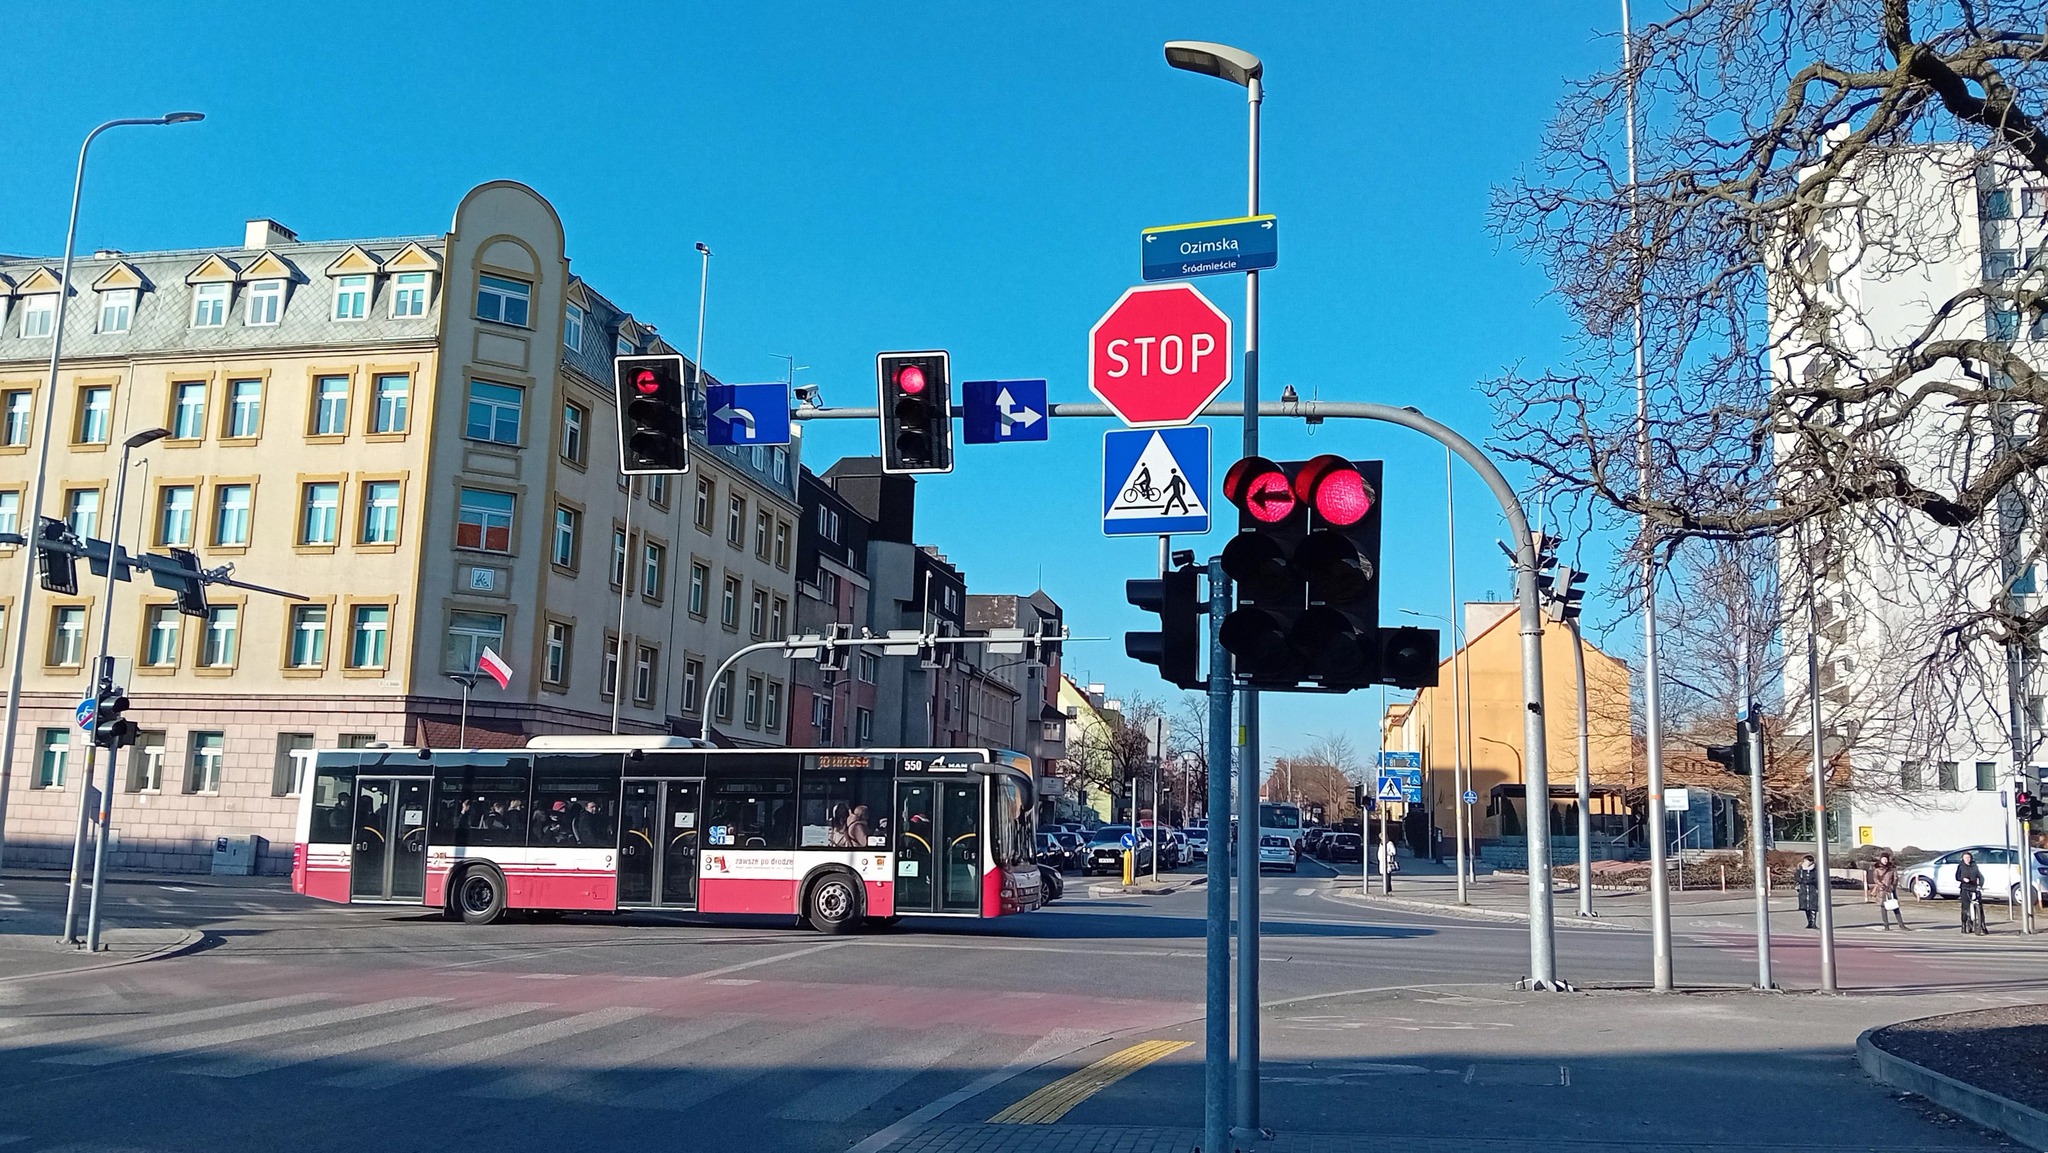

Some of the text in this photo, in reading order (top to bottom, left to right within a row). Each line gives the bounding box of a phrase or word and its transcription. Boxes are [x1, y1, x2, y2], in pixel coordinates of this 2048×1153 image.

[1182, 260, 1237, 274] Śródmieście
[1107, 333, 1215, 378] STOP
[904, 760, 922, 771] 550
[761, 858, 770, 866] po
